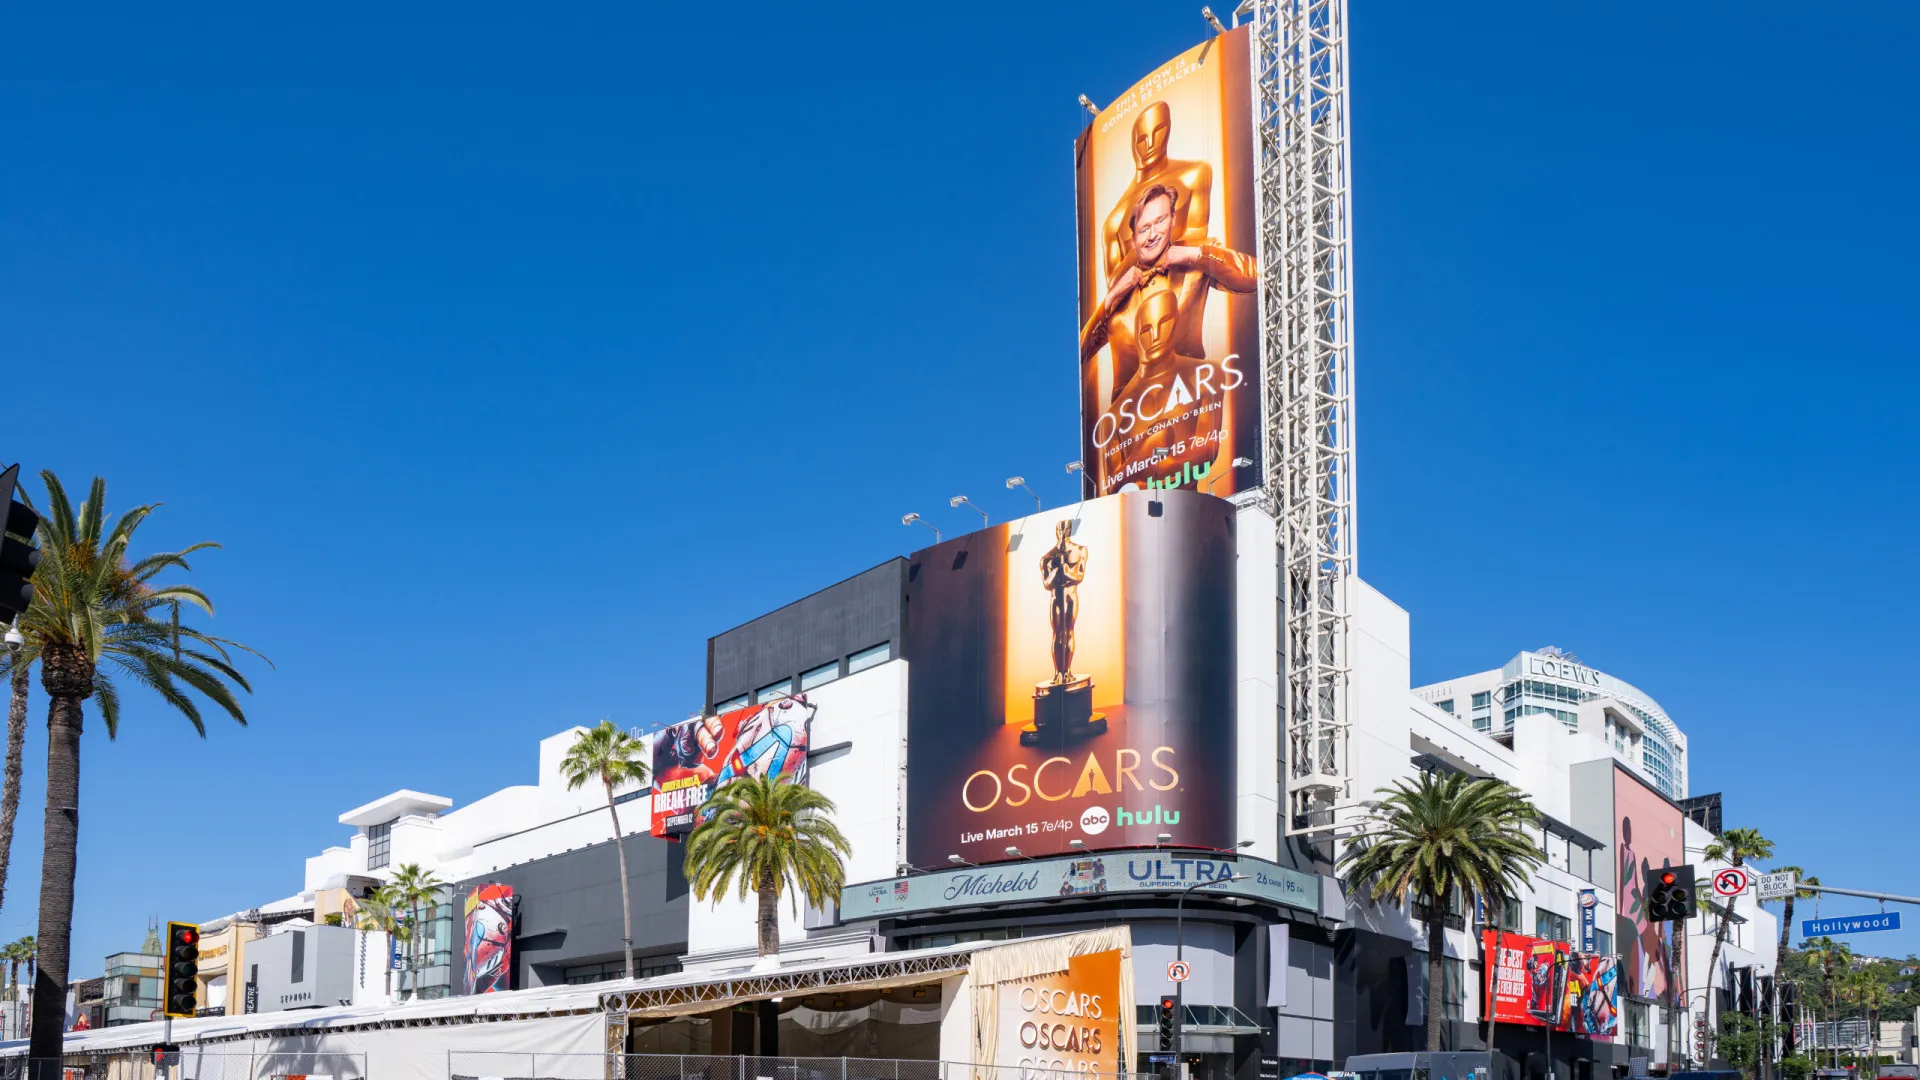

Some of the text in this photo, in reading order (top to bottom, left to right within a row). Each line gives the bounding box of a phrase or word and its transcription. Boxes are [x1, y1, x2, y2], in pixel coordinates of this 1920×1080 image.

[1116, 58, 1186, 112] THIS SHOW IS
[1102, 100, 1138, 133] GONNA
[1141, 90, 1153, 102] BE
[1092, 354, 1243, 449] OSCARS
[1105, 401, 1222, 459] HOSTED BY CONAN O'BRIEN
[1101, 472, 1124, 491] Live
[1170, 442, 1186, 457] 15
[1189, 428, 1229, 450] 7e/4p
[1147, 461, 1211, 491] hulu
[1530, 656, 1600, 687] LOEWS
[962, 746, 1179, 813] OSCARS
[654, 784, 709, 814] BREAK FREE
[1082, 813, 1108, 826] abc
[1116, 805, 1180, 826] hulu
[961, 819, 1073, 844] Live March 15 7e/4p
[943, 870, 1040, 900] Michelob
[1128, 859, 1236, 883] ULTRA
[1256, 872, 1268, 885] 2.6
[1286, 880, 1295, 892] 95
[1761, 874, 1789, 884] DO NOT
[1758, 889, 1794, 897] INTERSECTION
[1763, 882, 1788, 891] BLOCK
[1812, 917, 1890, 933] Hollywood
[247, 986, 255, 1014] HEATRE
[281, 992, 312, 1004] SEPHORA
[1018, 986, 1102, 1019] OSCARS
[1019, 1021, 1101, 1054] OSCARS
